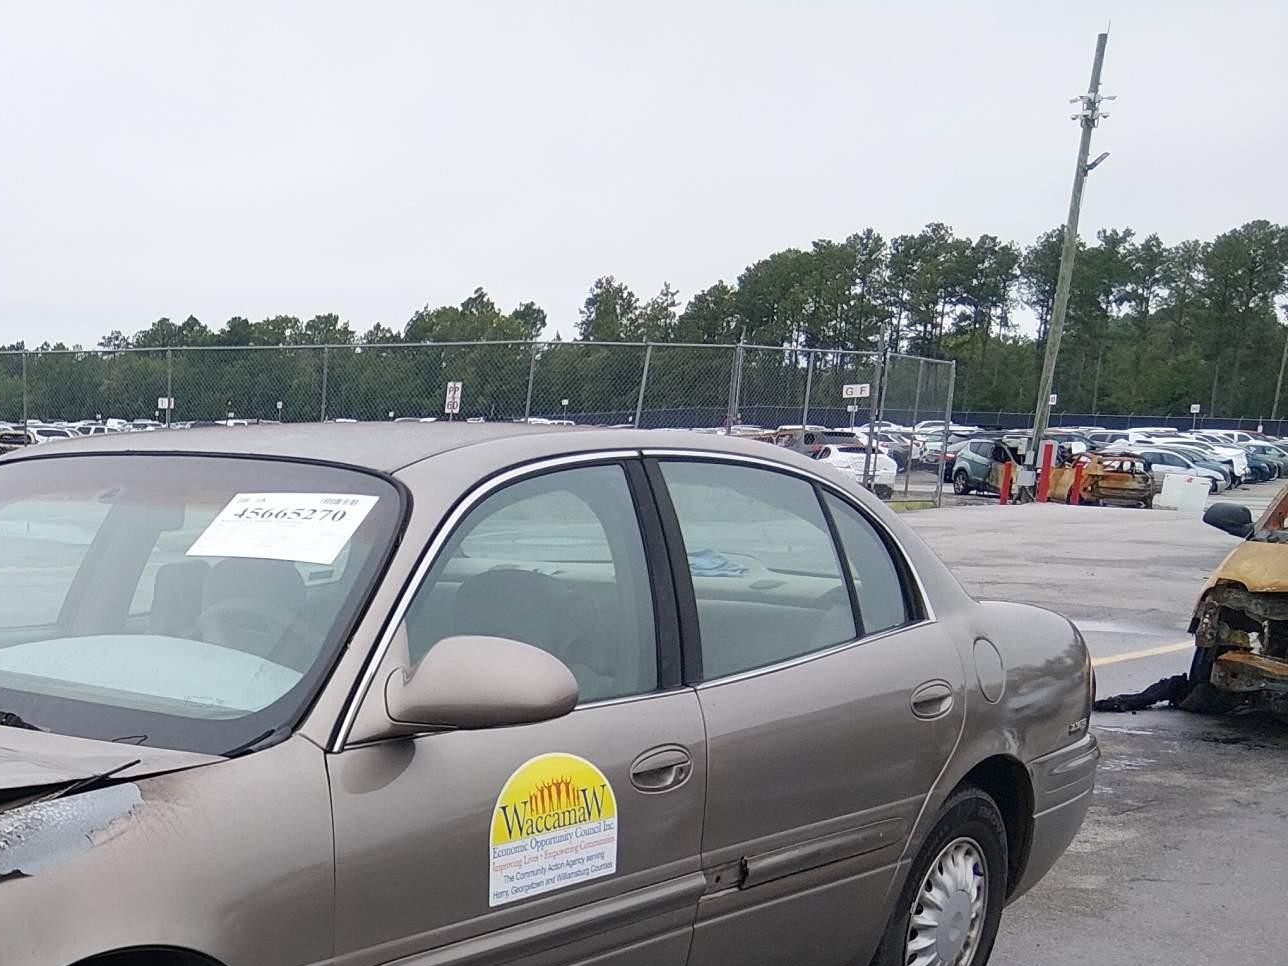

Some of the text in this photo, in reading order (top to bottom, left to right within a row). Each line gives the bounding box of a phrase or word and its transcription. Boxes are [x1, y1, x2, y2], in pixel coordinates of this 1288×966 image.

[845, 386, 867, 396] G F
[233, 507, 347, 522] 45665270
[500, 784, 607, 840] WaccamaW
[493, 844, 528, 859] Economic
[530, 834, 574, 852] Opportunity
[575, 822, 601, 838] Council
[504, 874, 514, 885] The
[515, 867, 546, 880] Community
[547, 861, 565, 872] Action
[565, 856, 585, 869] Agency
[511, 880, 545, 894] Georgetown
[545, 874, 556, 885] and
[557, 867, 590, 882] Williamsburg
[591, 861, 613, 873] Counties
